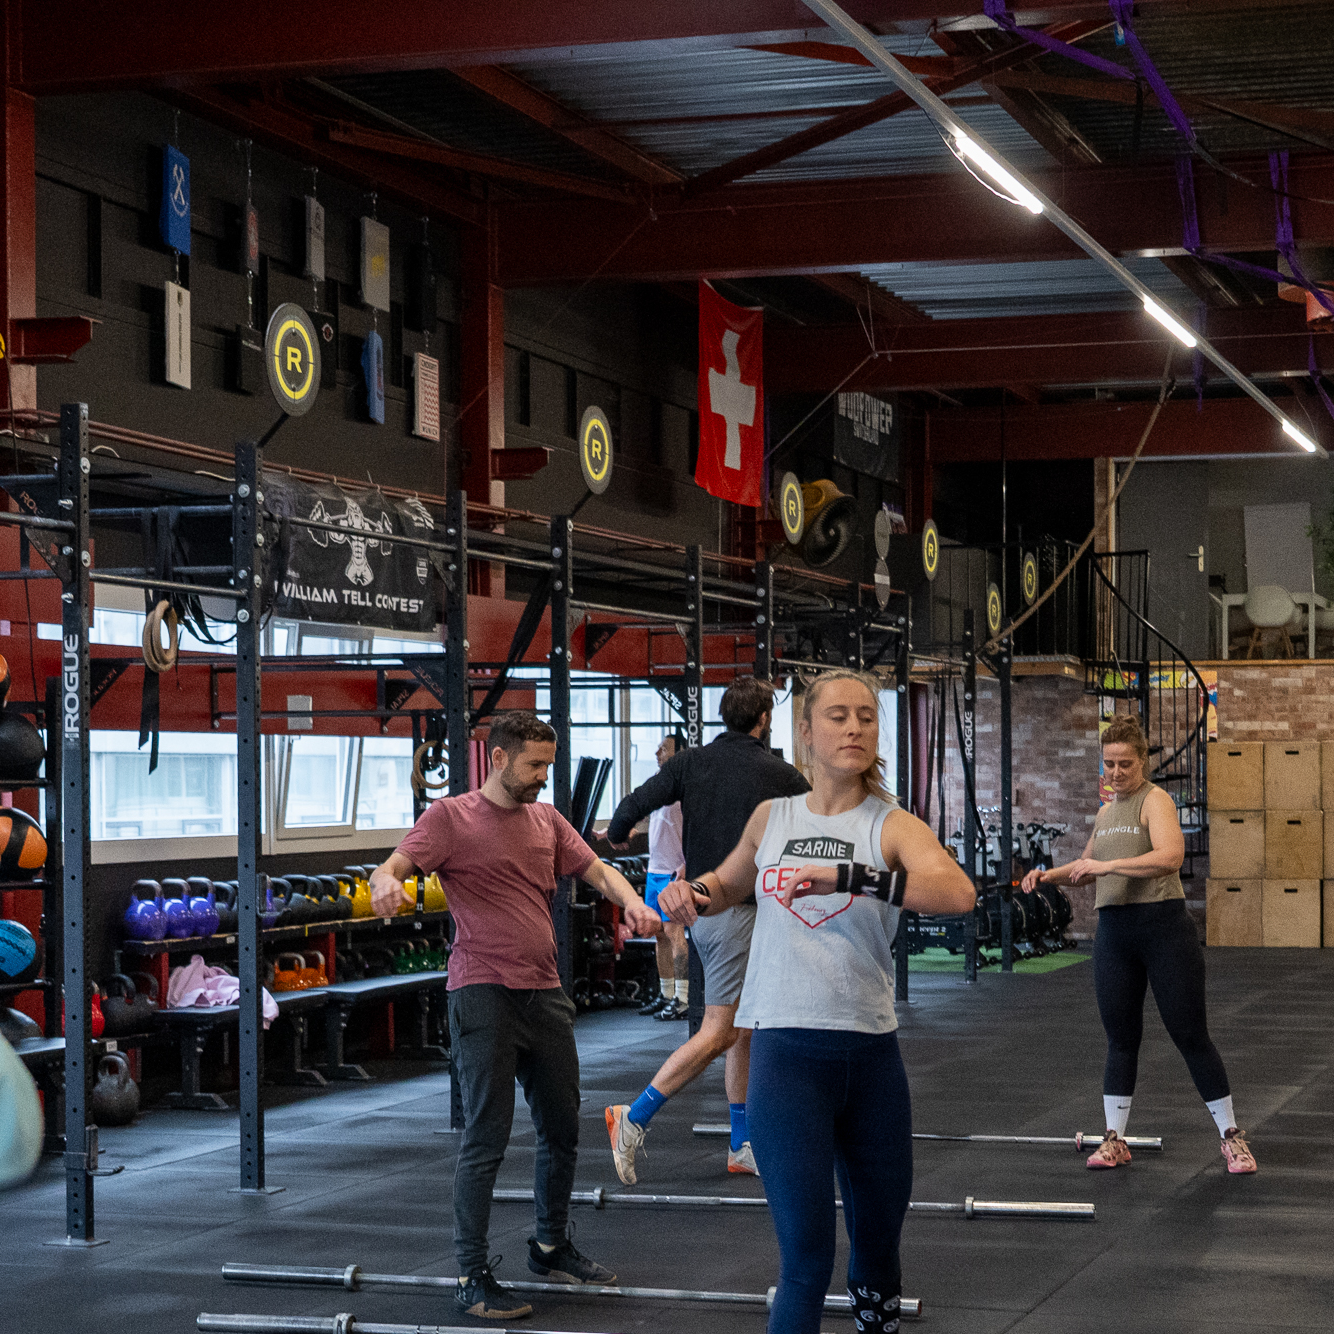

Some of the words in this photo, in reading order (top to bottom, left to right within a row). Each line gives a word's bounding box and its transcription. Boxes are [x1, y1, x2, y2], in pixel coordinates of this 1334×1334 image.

[286, 346, 302, 374] R
[592, 438, 602, 461] R
[789, 499, 796, 516] R
[928, 543, 934, 558] R
[342, 590, 372, 607] TELL
[64, 634, 80, 741] ROGUE
[688, 686, 699, 748] ROGUE
[964, 711, 973, 759] ROGUE
[792, 841, 847, 857] SARINE
